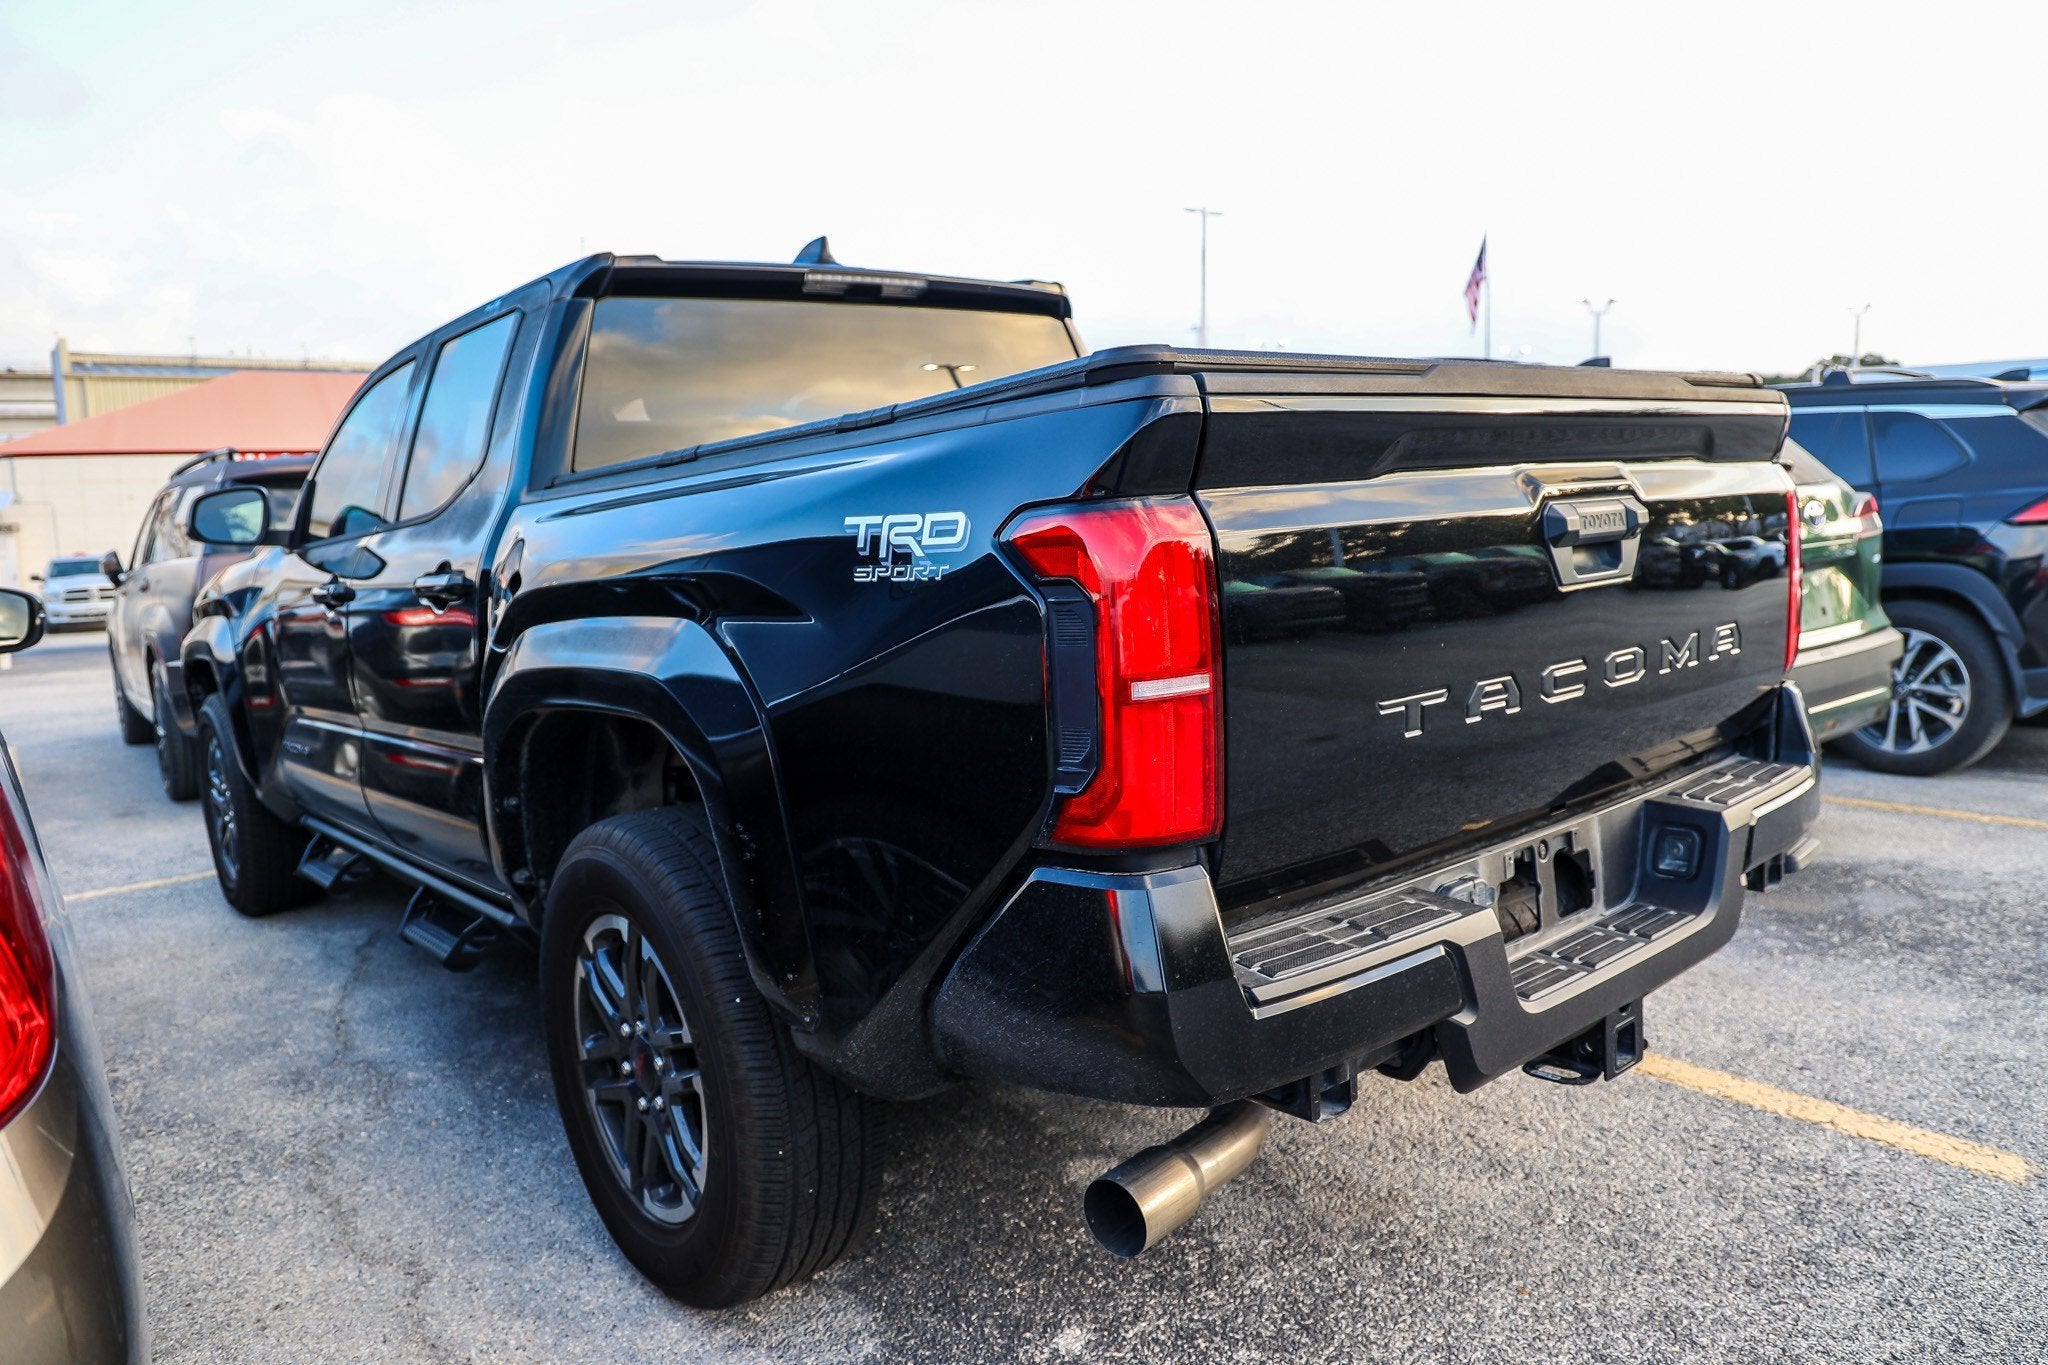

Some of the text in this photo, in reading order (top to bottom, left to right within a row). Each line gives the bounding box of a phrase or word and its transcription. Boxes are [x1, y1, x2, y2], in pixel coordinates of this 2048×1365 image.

[844, 511, 967, 558] TRD
[1581, 512, 1626, 530] TOYOTA
[853, 563, 949, 583] SPORT
[1376, 622, 1742, 739] TACOMA
